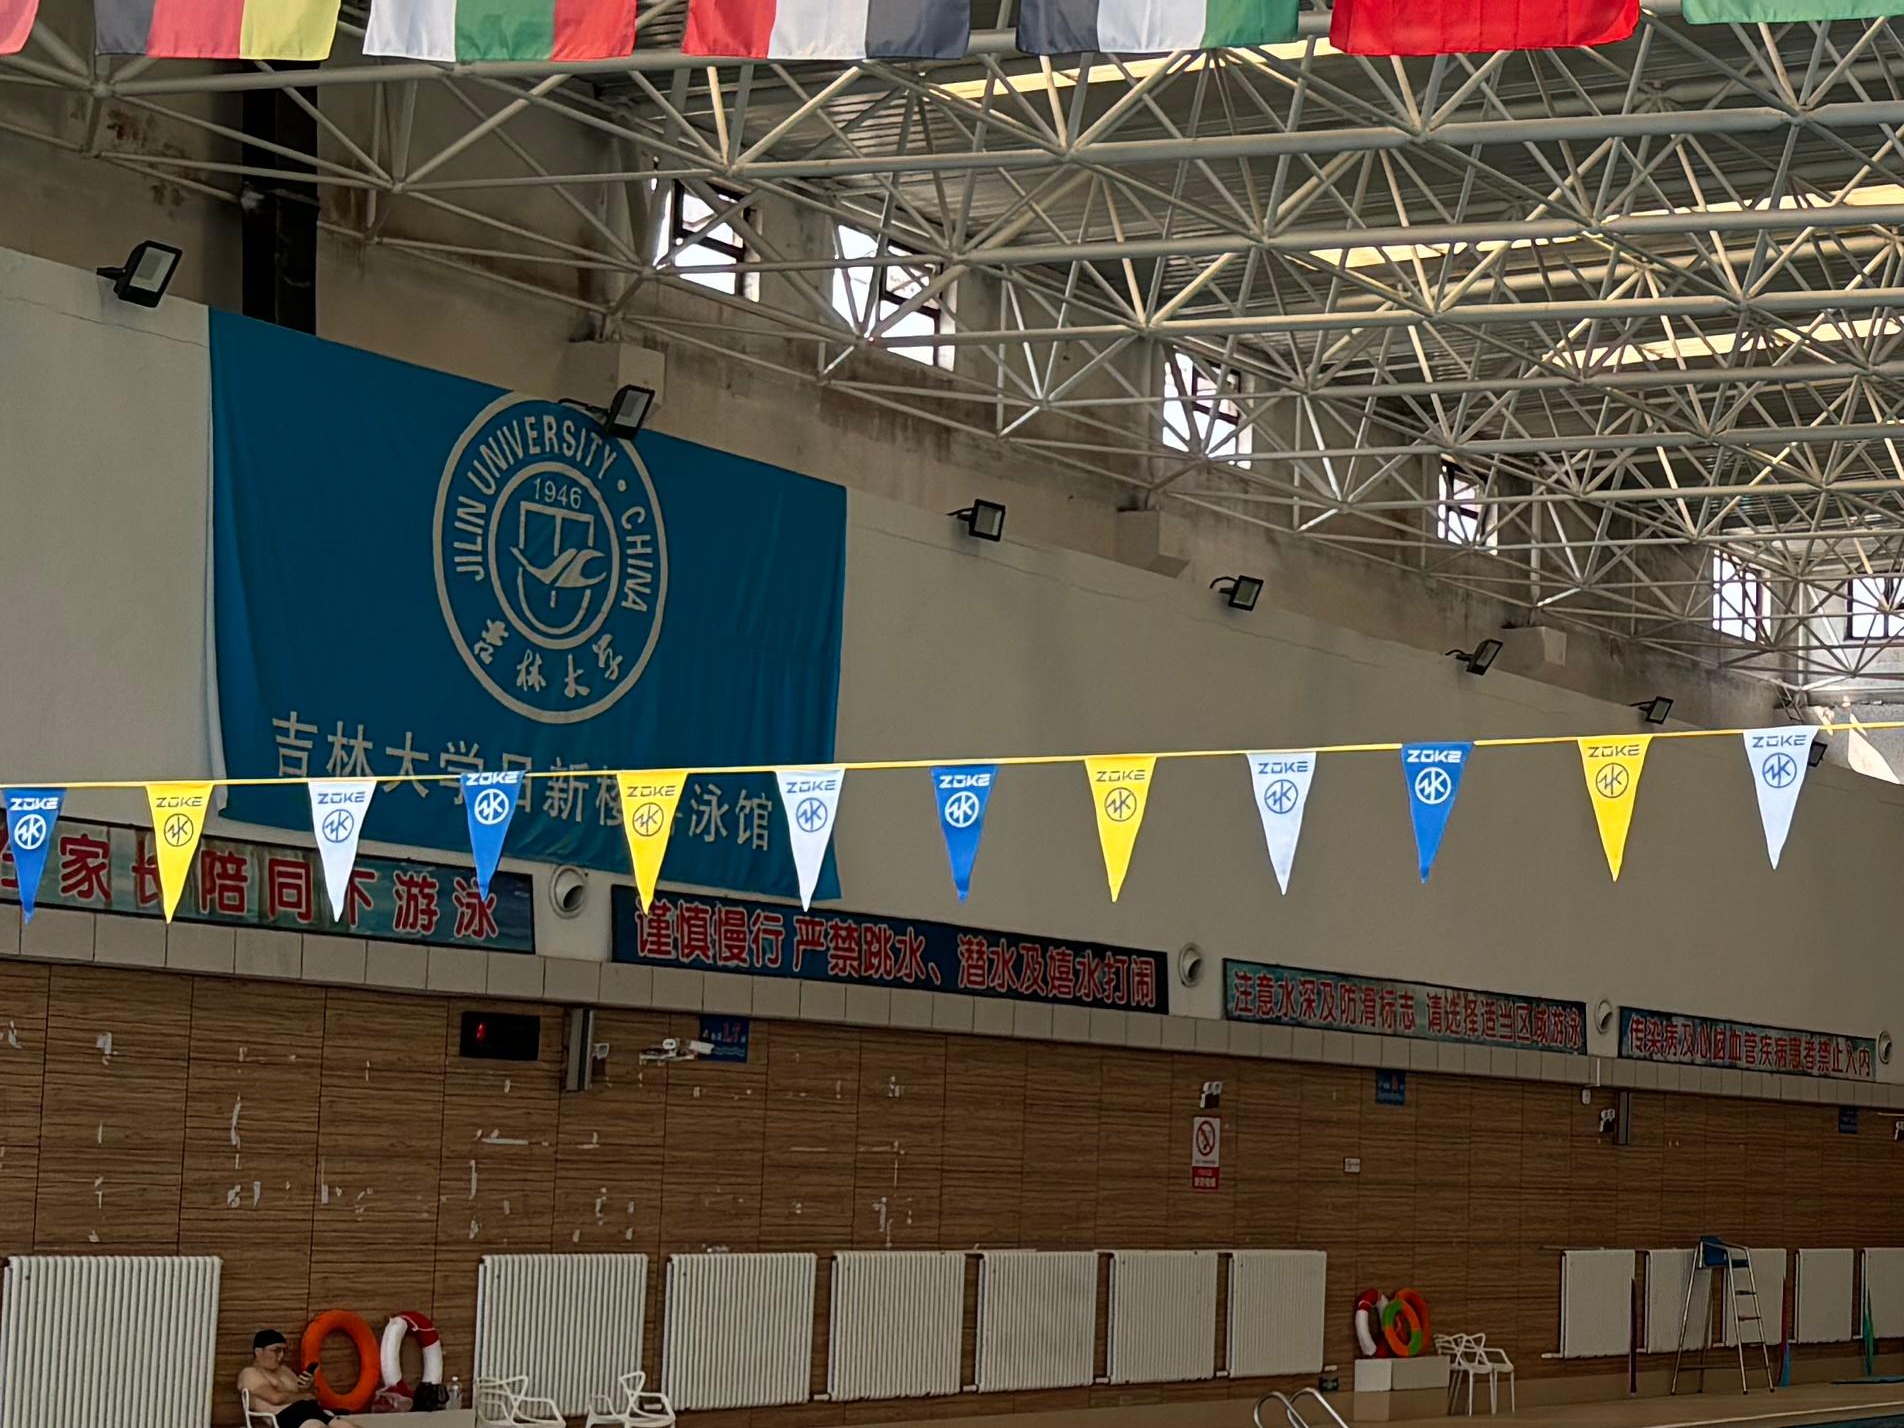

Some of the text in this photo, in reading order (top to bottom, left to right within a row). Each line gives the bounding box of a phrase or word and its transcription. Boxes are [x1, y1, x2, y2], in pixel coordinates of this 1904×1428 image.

[533, 477, 583, 510] 1946
[453, 415, 654, 613] JILIN UNIVERSITY CHINA
[1751, 734, 1806, 748] ZOKE
[1406, 750, 1461, 765] ZOKE
[1587, 744, 1640, 758] ZOKE
[1257, 761, 1308, 775] ZOKE
[272, 710, 774, 851] 吉林大学日新楼泳馆
[938, 774, 990, 788] ZOKE
[1095, 769, 1145, 783] ZOKE
[626, 785, 676, 799] ZOKE
[785, 780, 837, 794] ZOKE
[10, 797, 59, 811] ZOKE
[156, 797, 203, 808] ZOKE
[317, 791, 366, 805] ZOKE
[0, 827, 499, 940] 家长陪同下游泳
[635, 898, 784, 969] 谨慎慢行
[1234, 971, 1583, 1050] 注意水深及防滑标志 请选择适当区域游泳
